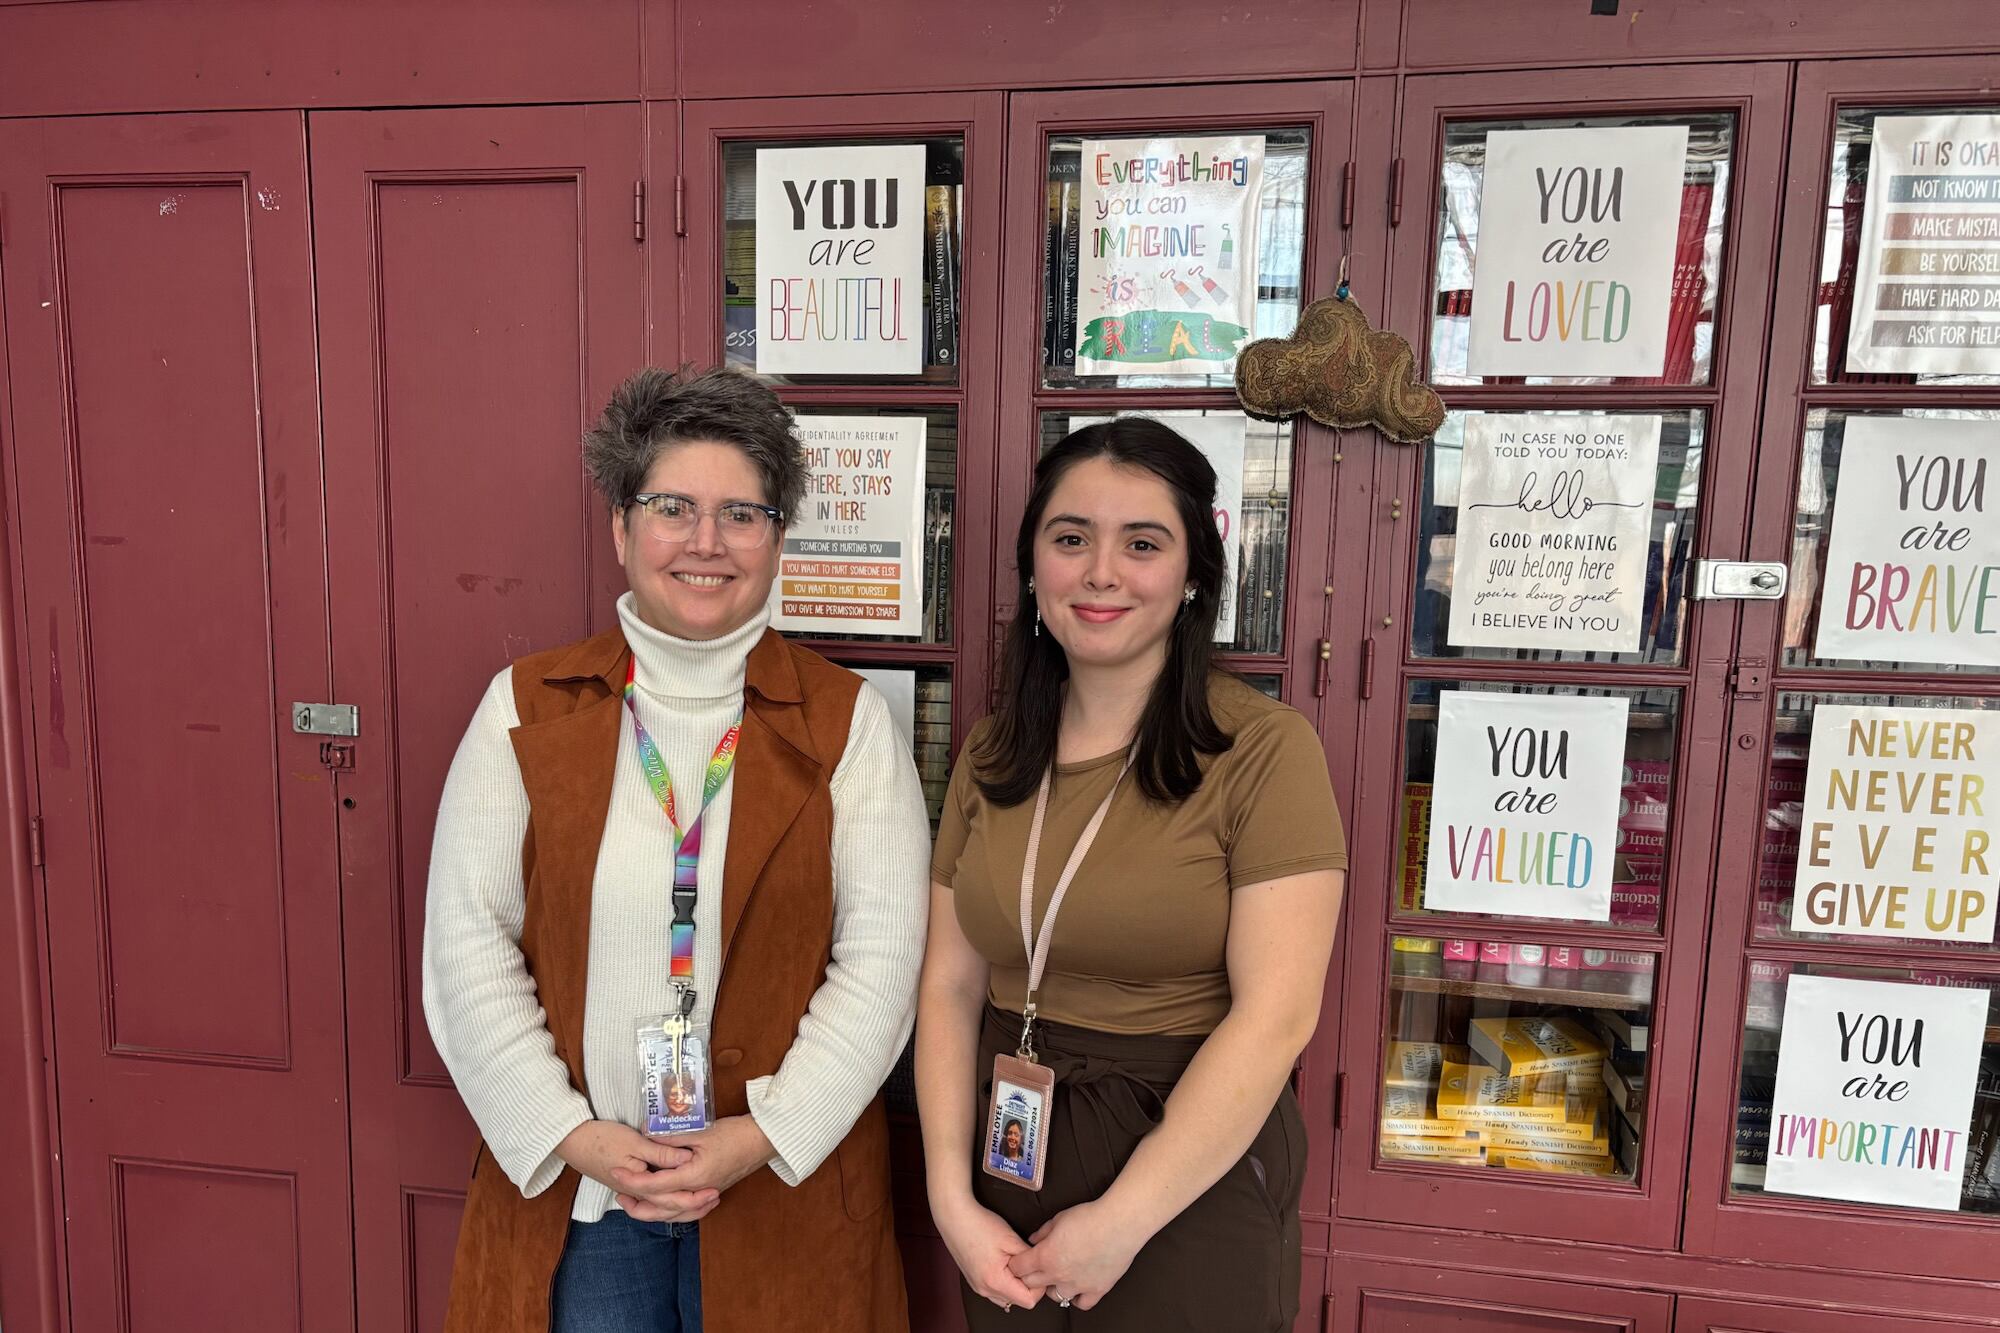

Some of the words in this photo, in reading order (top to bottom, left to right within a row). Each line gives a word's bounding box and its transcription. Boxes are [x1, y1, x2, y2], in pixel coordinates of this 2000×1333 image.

[1912, 141, 1930, 166] IT
[1935, 141, 1953, 166] IS
[1536, 166, 1624, 224] YOU
[1912, 179, 1940, 199] NOT
[1944, 179, 1989, 199] KNOW
[782, 178, 898, 231] YOU
[1095, 198, 1142, 220] you
[1147, 195, 1187, 215] can
[1912, 217, 1954, 236] MAKE
[809, 238, 875, 266] are
[1093, 224, 1206, 259] IMAGINE
[1542, 232, 1610, 263] are
[1920, 252, 1937, 272] BE
[1111, 275, 1135, 302] is
[1901, 288, 1938, 307] HAVE
[1940, 288, 1980, 307] HARD
[770, 277, 907, 341] BEAUTIFUL
[1503, 280, 1632, 343] LOVED
[1101, 318, 1226, 357] REAL
[1907, 325, 1936, 344] ASK
[1940, 325, 1966, 345] FOR
[856, 431, 899, 441] AGREEMENT
[1499, 433, 1515, 443] IN
[1522, 433, 1556, 444] CASE
[1563, 434, 1586, 445] NO
[1594, 434, 1625, 445] ONE
[835, 448, 862, 468] YOU
[867, 448, 891, 469] SAY
[1495, 447, 1530, 457] TOLD
[1538, 447, 1568, 458] YOU
[1576, 448, 1628, 460] TODAY:
[853, 475, 892, 496] STAYS
[1896, 455, 1987, 512] YOU
[817, 501, 830, 520] IN
[835, 501, 867, 521] HERE
[824, 524, 860, 534] UNLESS
[1489, 533, 1532, 549] GOOD
[1540, 533, 1617, 551] MORNING
[1900, 520, 1971, 551] are
[800, 541, 830, 552] SOMEONE
[832, 542, 839, 552] IS
[840, 542, 867, 553] HURTING
[869, 543, 883, 553] YOU
[786, 563, 799, 573] YOU
[800, 564, 819, 574] WANT
[822, 564, 830, 574] TO
[831, 565, 848, 575] HURT
[850, 565, 880, 576] SOMEONE
[881, 566, 896, 576] ELSE
[1487, 559, 1516, 583] you
[1521, 553, 1573, 586] belong
[1578, 555, 1614, 580] here
[793, 583, 806, 593] YOU
[807, 584, 827, 594] WANT
[829, 584, 837, 594] TO
[838, 585, 855, 595] HURT
[857, 585, 889, 596] YOURSELF
[1474, 587, 1519, 605] you're
[1525, 582, 1566, 611] doing
[1569, 587, 1622, 612] great
[1845, 562, 2000, 634] BRAVE
[784, 603, 798, 613] YOU
[799, 604, 813, 613] GIVE
[815, 604, 824, 615] ME
[826, 605, 864, 616] PERMISSION
[865, 606, 874, 616] TO
[876, 607, 897, 617] SHARE
[1472, 613, 1476, 626] I
[1482, 613, 1547, 629] BELIEVE
[1554, 616, 1573, 629] IN
[1579, 616, 1619, 632] YOU
[1487, 725, 1569, 780] YOU
[1847, 719, 1976, 761] NEVER
[1494, 786, 1557, 814] are
[1826, 768, 1985, 817] NEVER
[1448, 824, 1593, 889] VALUED
[1805, 881, 1909, 930] GIVE
[1924, 887, 1985, 933] UP
[1837, 1011, 1924, 1068] YOU
[647, 1052, 658, 1115] EMPLOYEE
[1841, 1073, 1909, 1102] are
[659, 1115, 701, 1124] Waldecker
[991, 1104, 1003, 1154] EMPLOYEE
[1774, 1114, 1962, 1172] IMPORTANT
